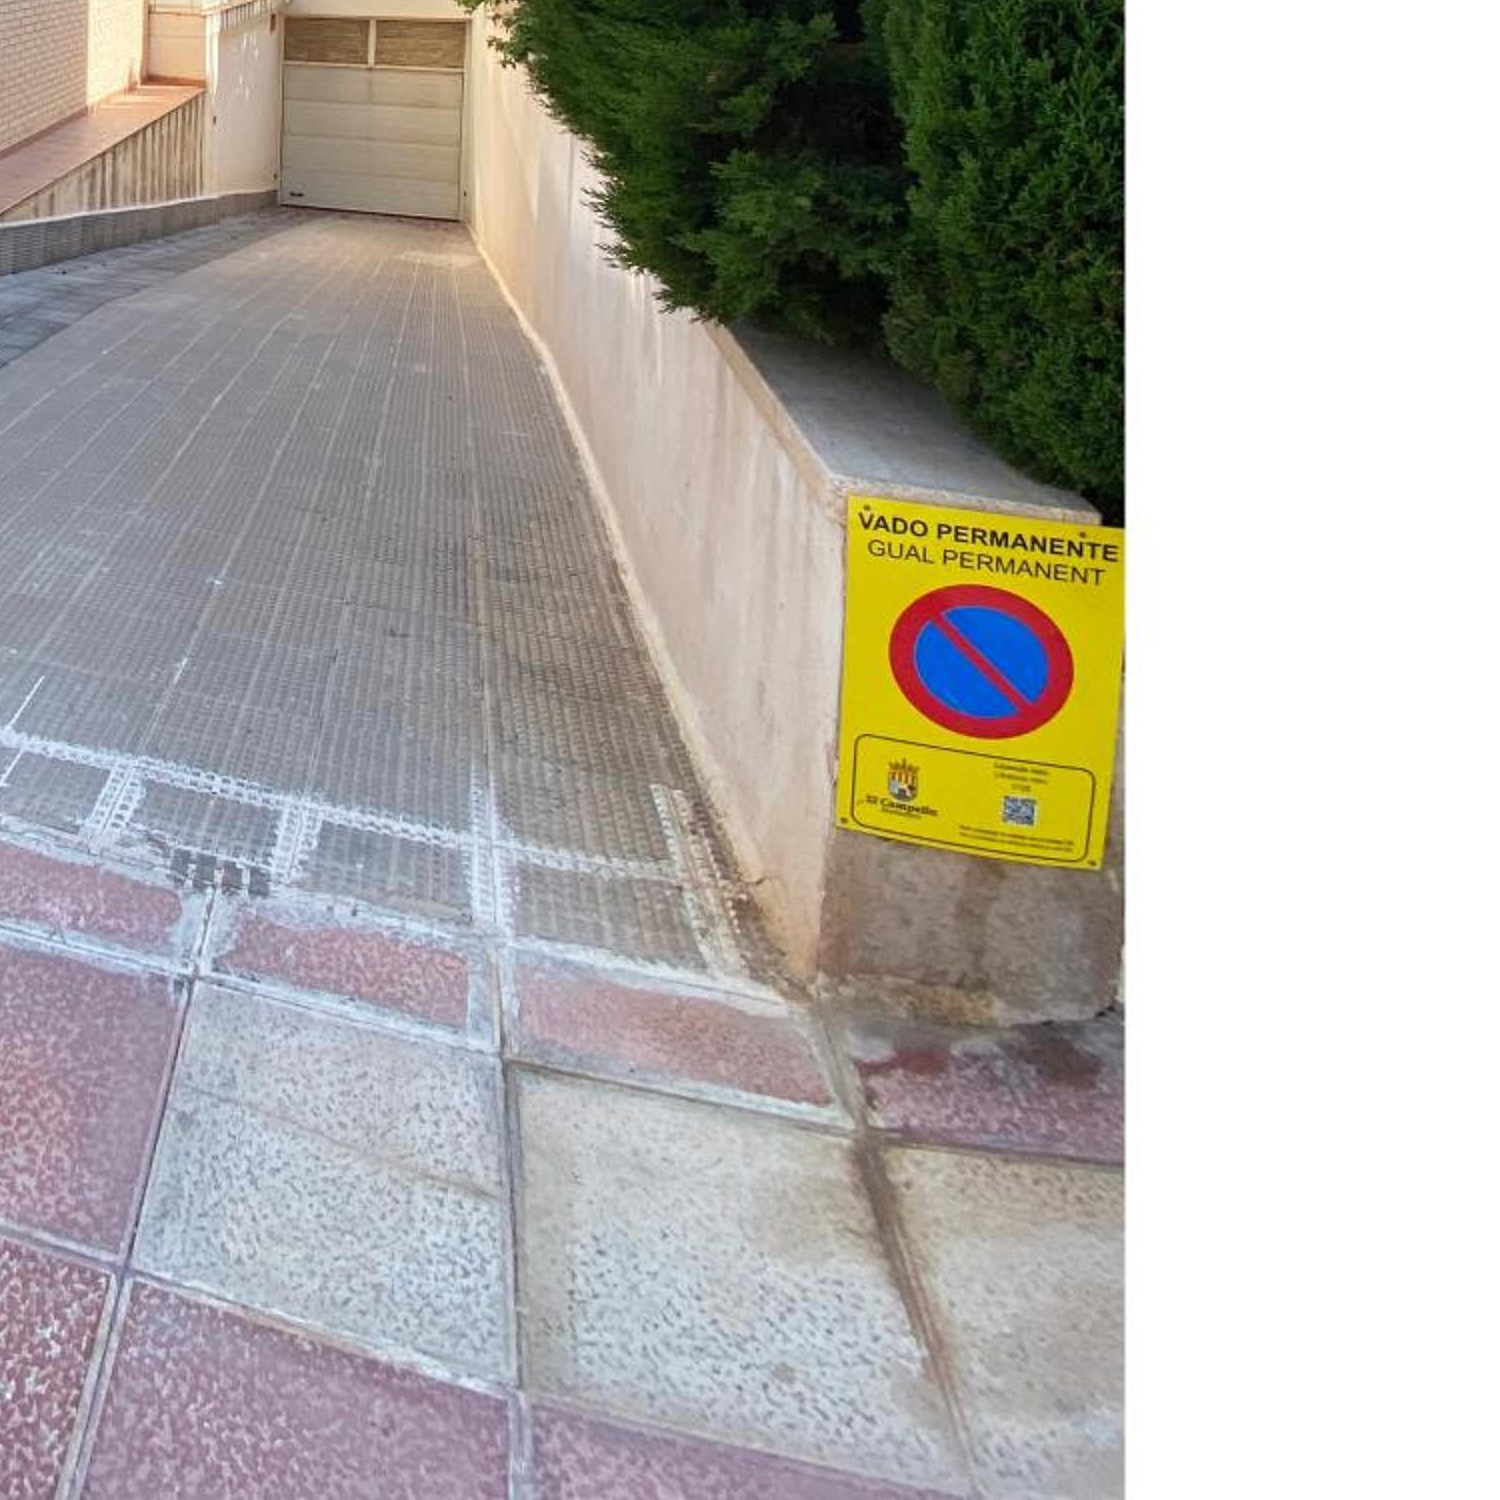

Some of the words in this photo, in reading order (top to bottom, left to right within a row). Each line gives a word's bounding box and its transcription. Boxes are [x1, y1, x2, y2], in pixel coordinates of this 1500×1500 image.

[858, 512, 929, 537] VADO
[937, 523, 1119, 563] PERMANENTE
[868, 539, 935, 565] GUAL
[943, 549, 1106, 586] PERMANENT
